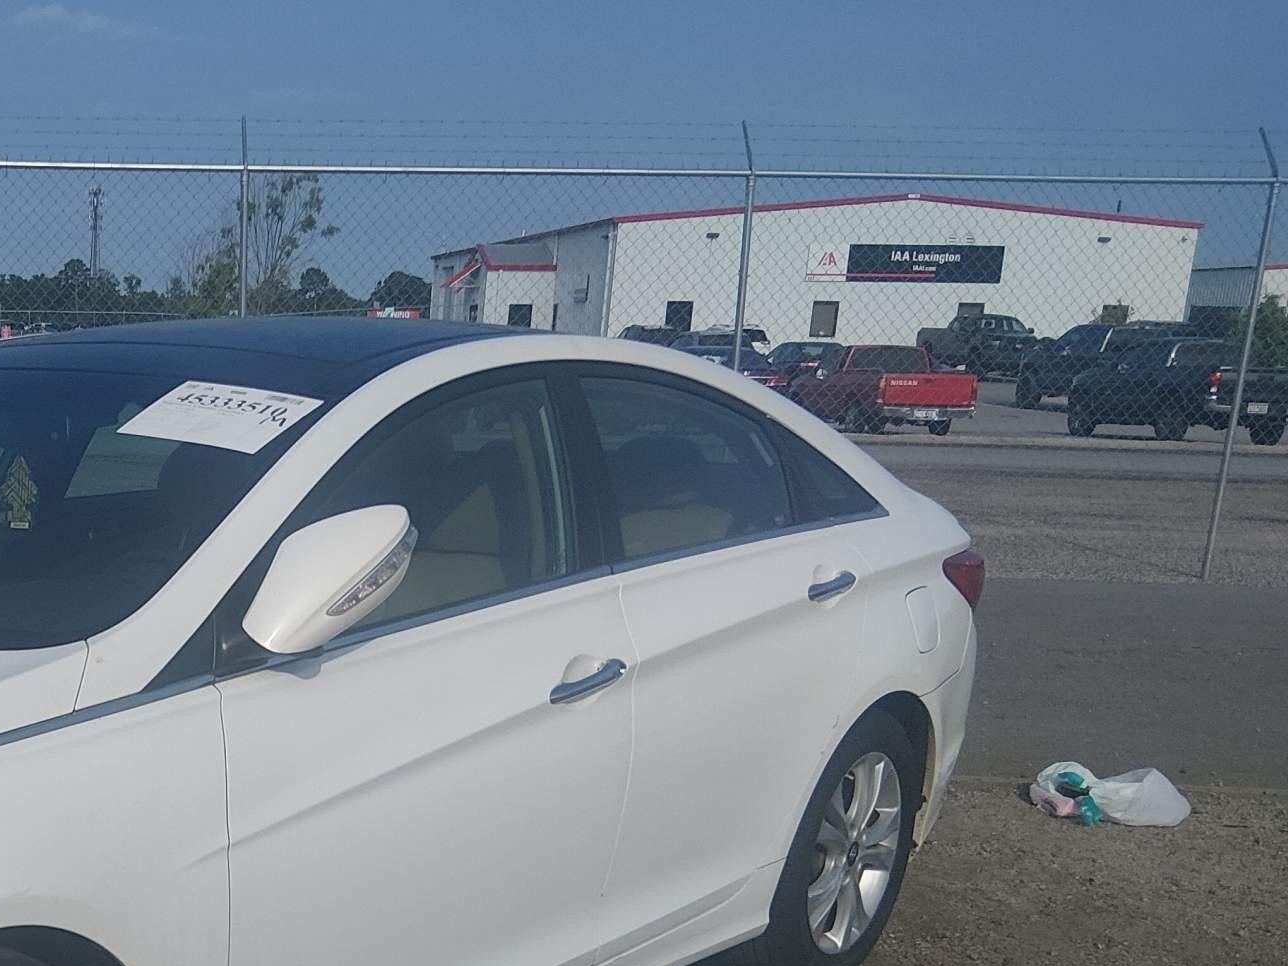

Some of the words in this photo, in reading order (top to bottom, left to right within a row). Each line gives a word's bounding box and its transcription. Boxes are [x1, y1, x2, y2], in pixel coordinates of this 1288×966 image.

[890, 251, 910, 262] IAA
[912, 251, 961, 264] Lexington
[177, 393, 288, 417] 45333510
